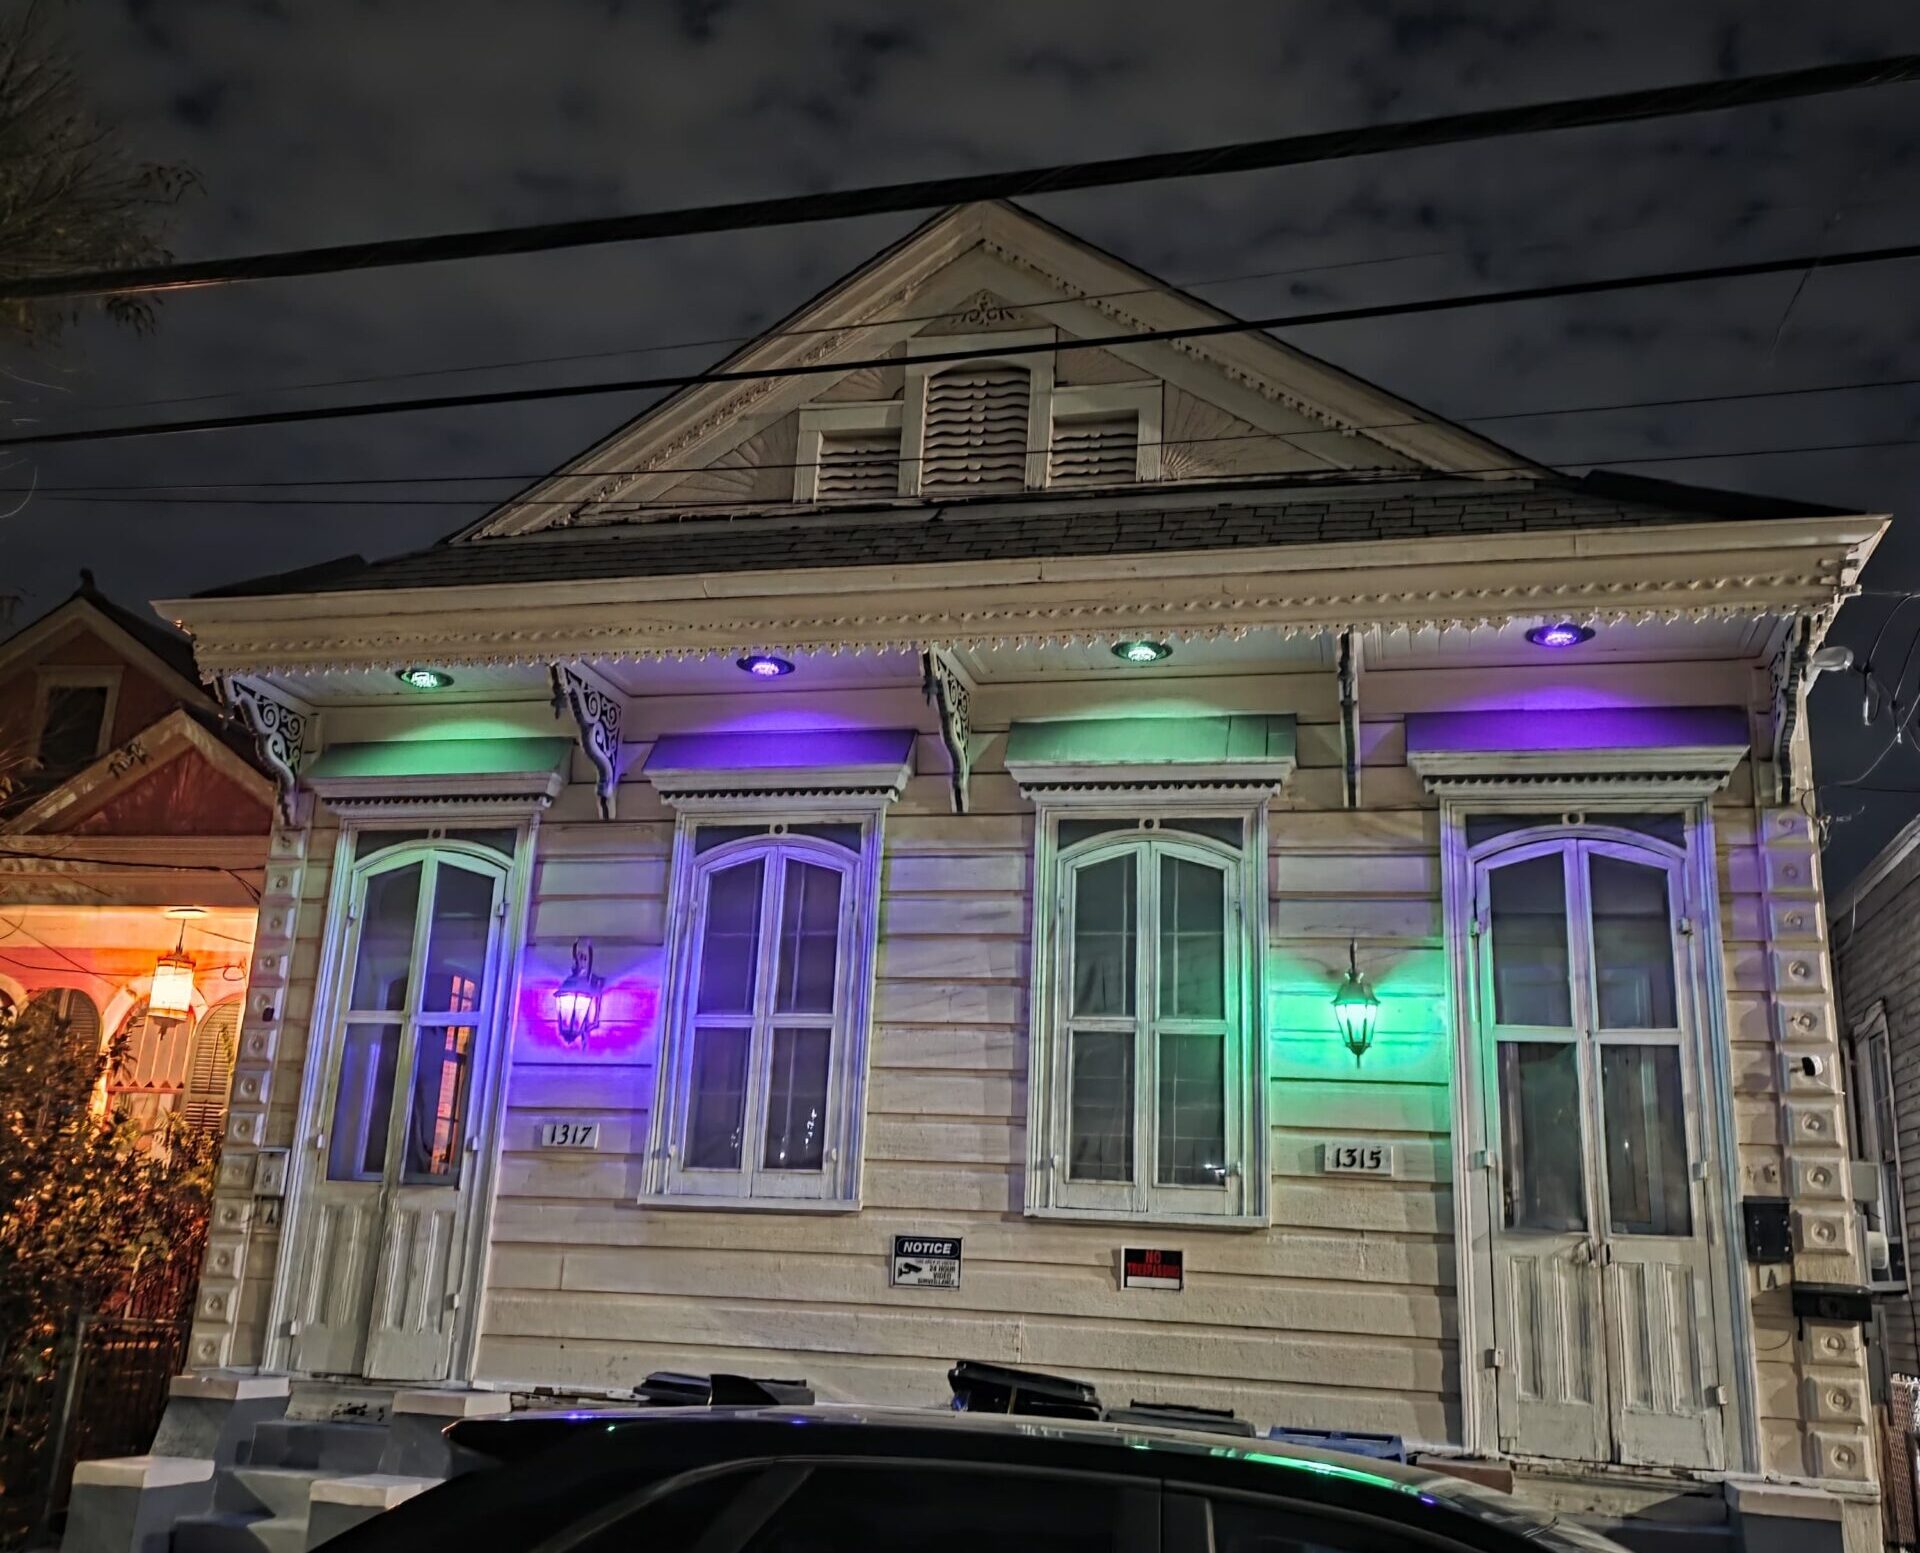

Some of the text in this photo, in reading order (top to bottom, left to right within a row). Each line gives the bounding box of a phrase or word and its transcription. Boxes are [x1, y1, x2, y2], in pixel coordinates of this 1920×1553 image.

[550, 1123, 593, 1145] 1317
[1335, 1147, 1383, 1169] 1315
[903, 1241, 952, 1254] NOTICE
[1766, 1269, 1780, 1289] A
